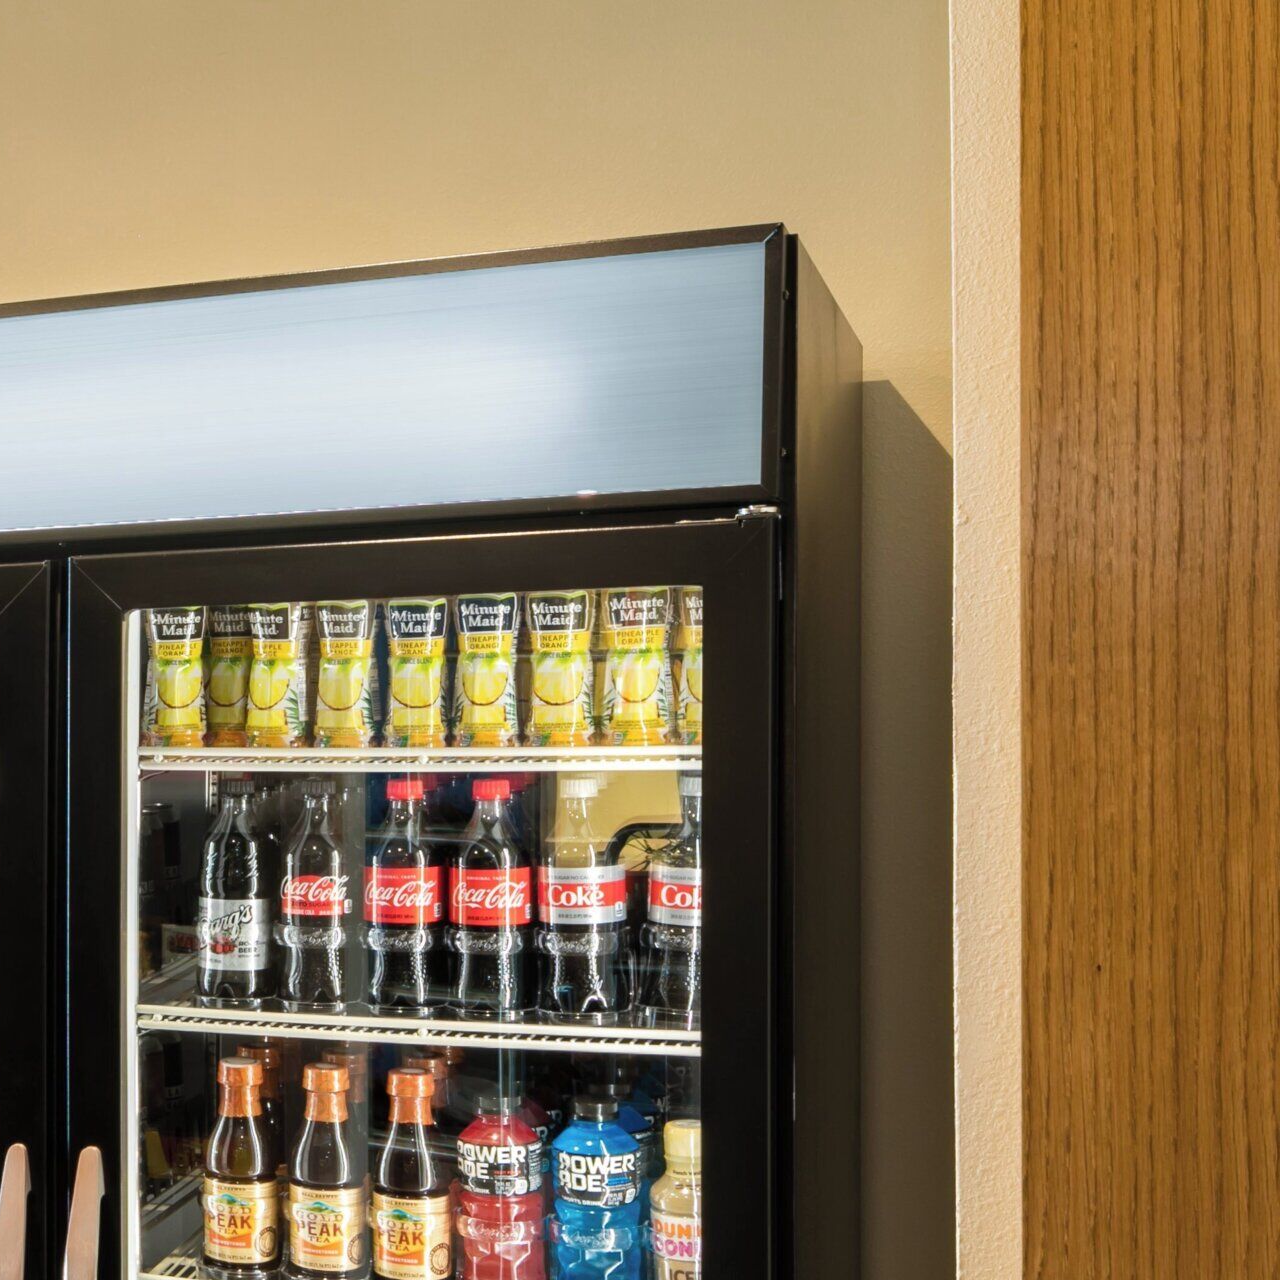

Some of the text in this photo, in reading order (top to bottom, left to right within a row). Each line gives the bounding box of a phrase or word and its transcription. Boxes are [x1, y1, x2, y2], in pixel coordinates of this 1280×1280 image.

[462, 604, 511, 616] Minute
[281, 874, 350, 903] Coca-Cola
[365, 880, 436, 907] Coca-Cola
[453, 881, 528, 909] Coca-Cola
[548, 884, 605, 907] Coke
[457, 1140, 528, 1164] POWER
[558, 1152, 635, 1174] POWER
[558, 1170, 601, 1192] ADE
[210, 1201, 252, 1214] OLD
[207, 1210, 252, 1229] PEAK
[296, 1219, 343, 1237] PEAK
[379, 1214, 424, 1231] OLD
[378, 1228, 425, 1246] PEAK
